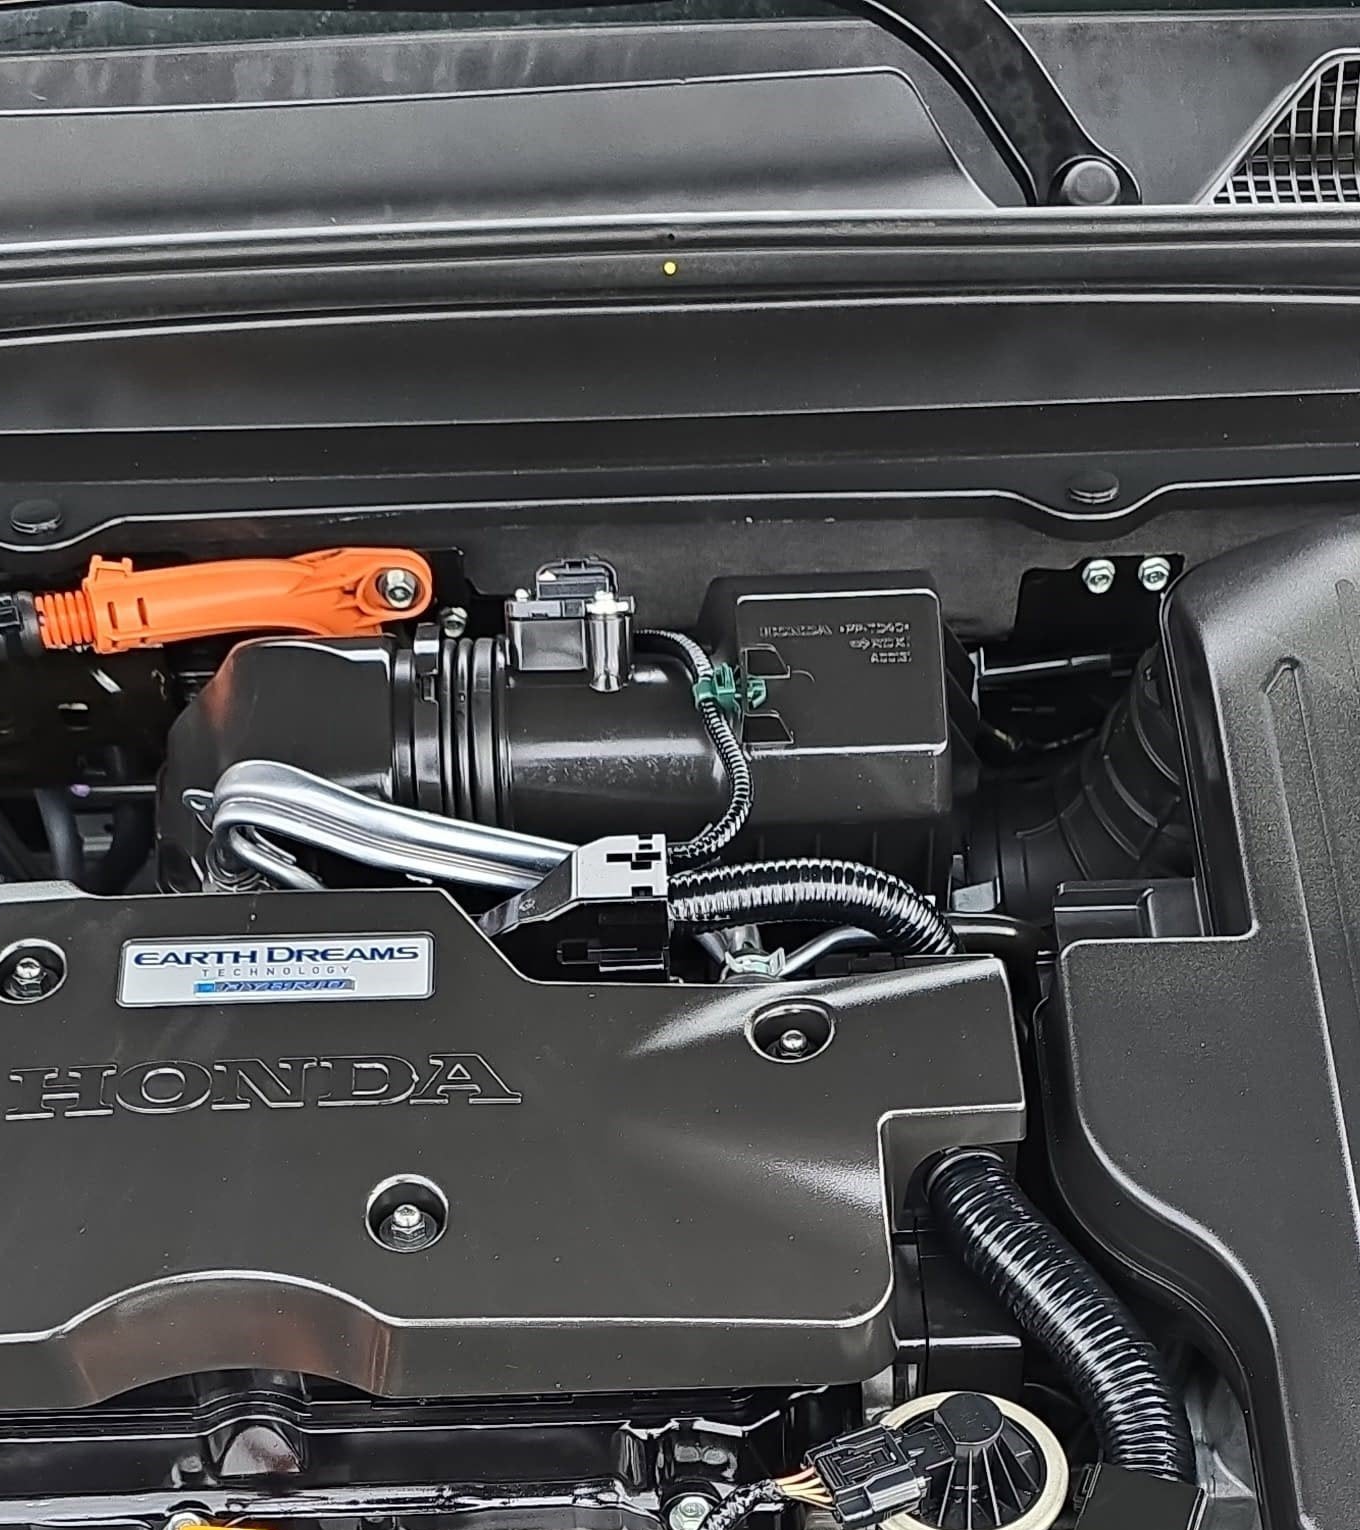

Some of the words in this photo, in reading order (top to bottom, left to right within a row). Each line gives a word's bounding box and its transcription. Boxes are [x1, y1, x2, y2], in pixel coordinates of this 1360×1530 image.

[133, 946, 258, 967] EARTH
[267, 945, 419, 962] DREAMS
[201, 965, 351, 978] TECHNOLOGY
[5, 1053, 522, 1120] HONDA
